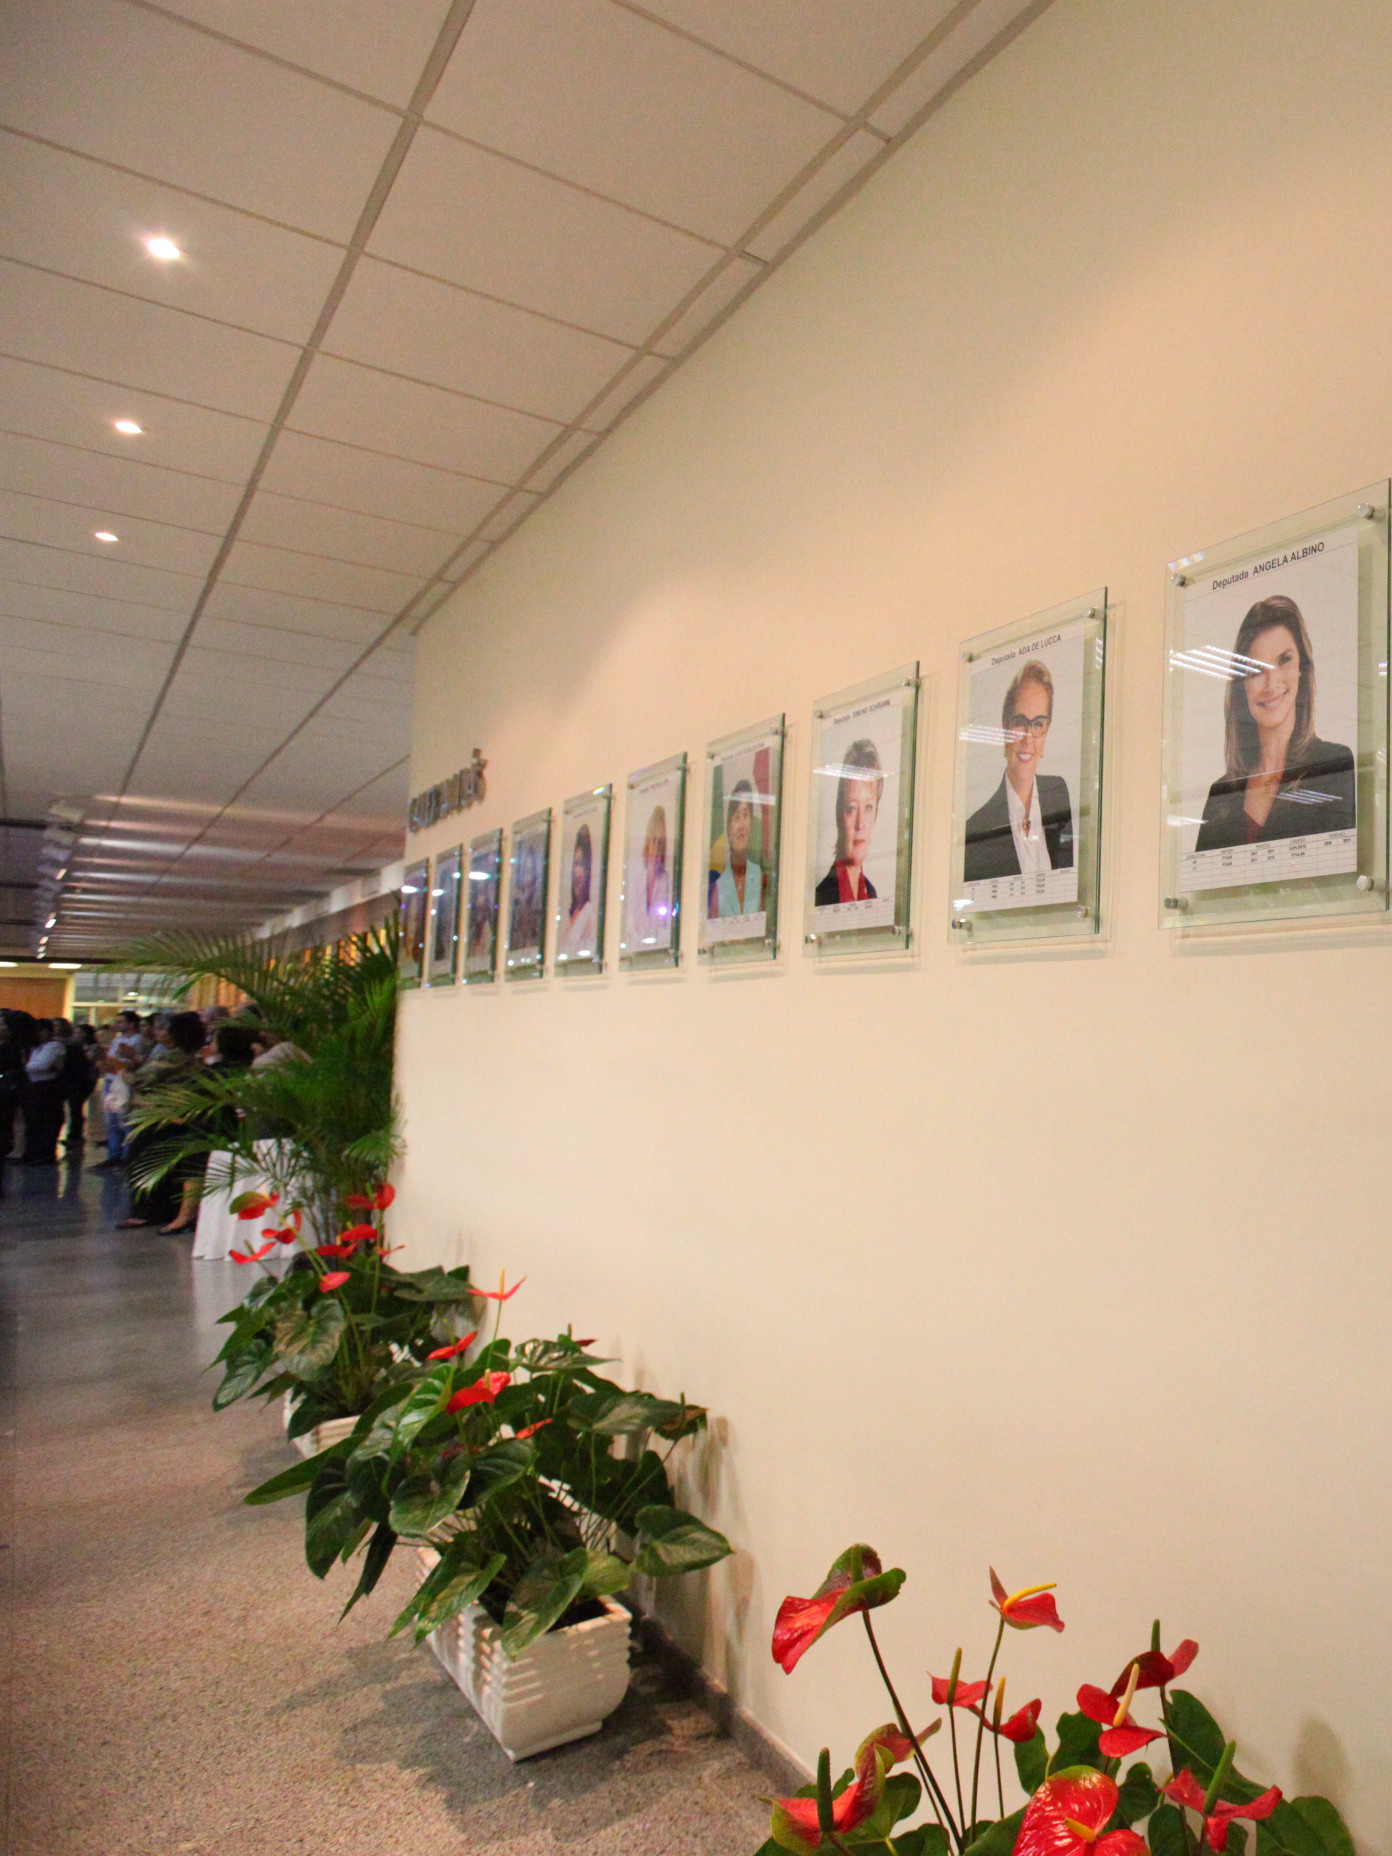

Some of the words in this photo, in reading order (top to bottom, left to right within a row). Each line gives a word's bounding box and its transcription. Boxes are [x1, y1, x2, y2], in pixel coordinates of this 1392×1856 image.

[1212, 570, 1249, 591] Deputada
[1252, 555, 1289, 577] ANGELA
[1290, 541, 1325, 563] ALBINO
[1018, 645, 1031, 656] ADA
[1031, 641, 1040, 652] DE
